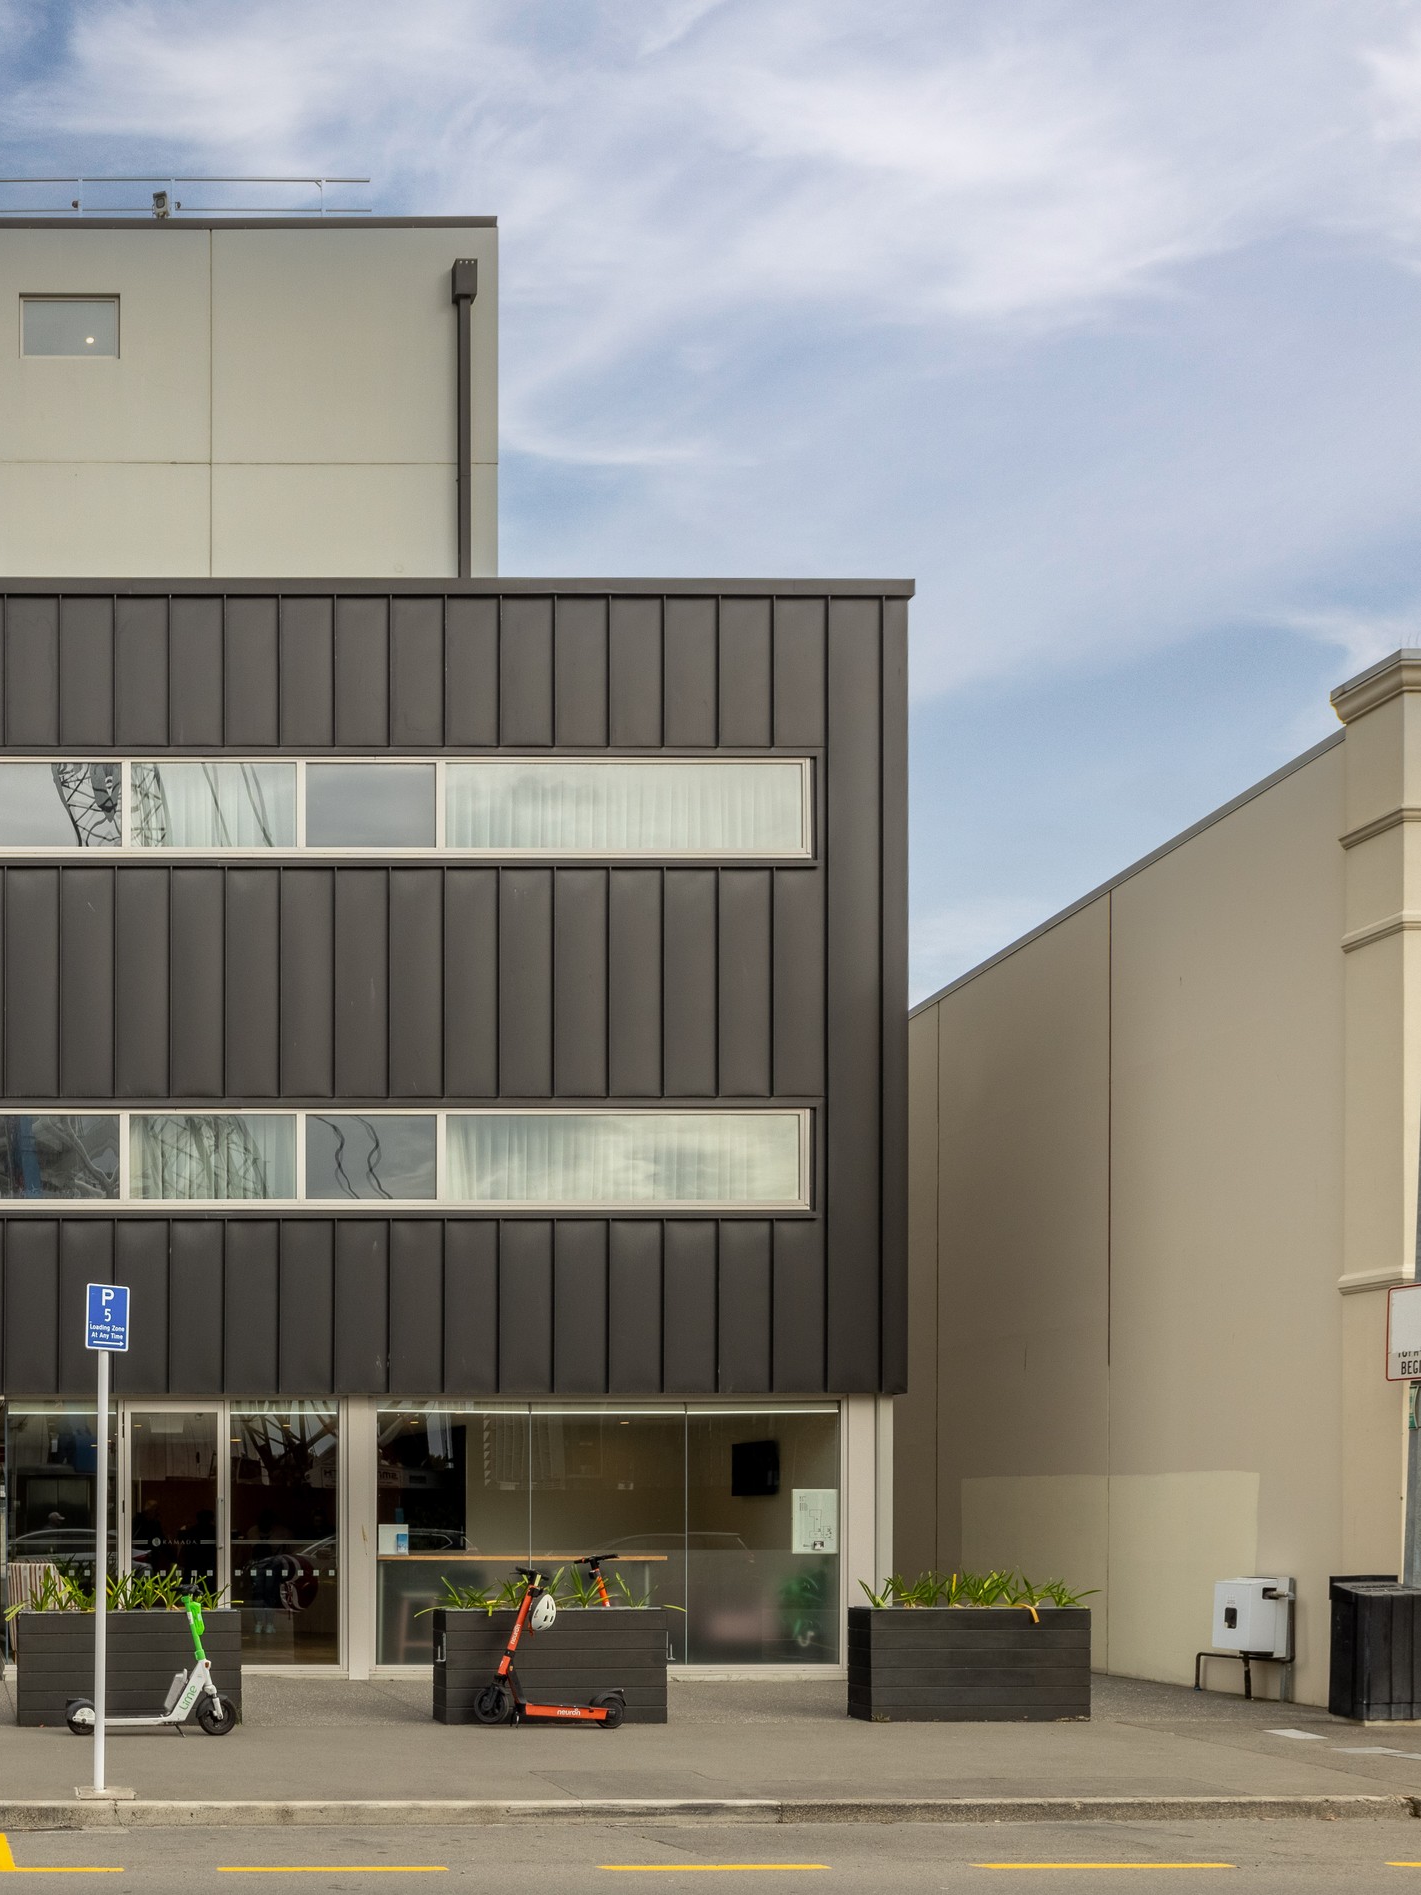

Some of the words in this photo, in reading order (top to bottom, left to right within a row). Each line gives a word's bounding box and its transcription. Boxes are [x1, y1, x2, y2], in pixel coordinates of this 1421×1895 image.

[101, 1289, 115, 1306] P
[104, 1308, 112, 1322] 5
[89, 1323, 111, 1332] Loading
[99, 1332, 109, 1340] Any
[110, 1332, 123, 1340] Time
[179, 1685, 197, 1710] Lime
[556, 1708, 581, 1716] neuron
